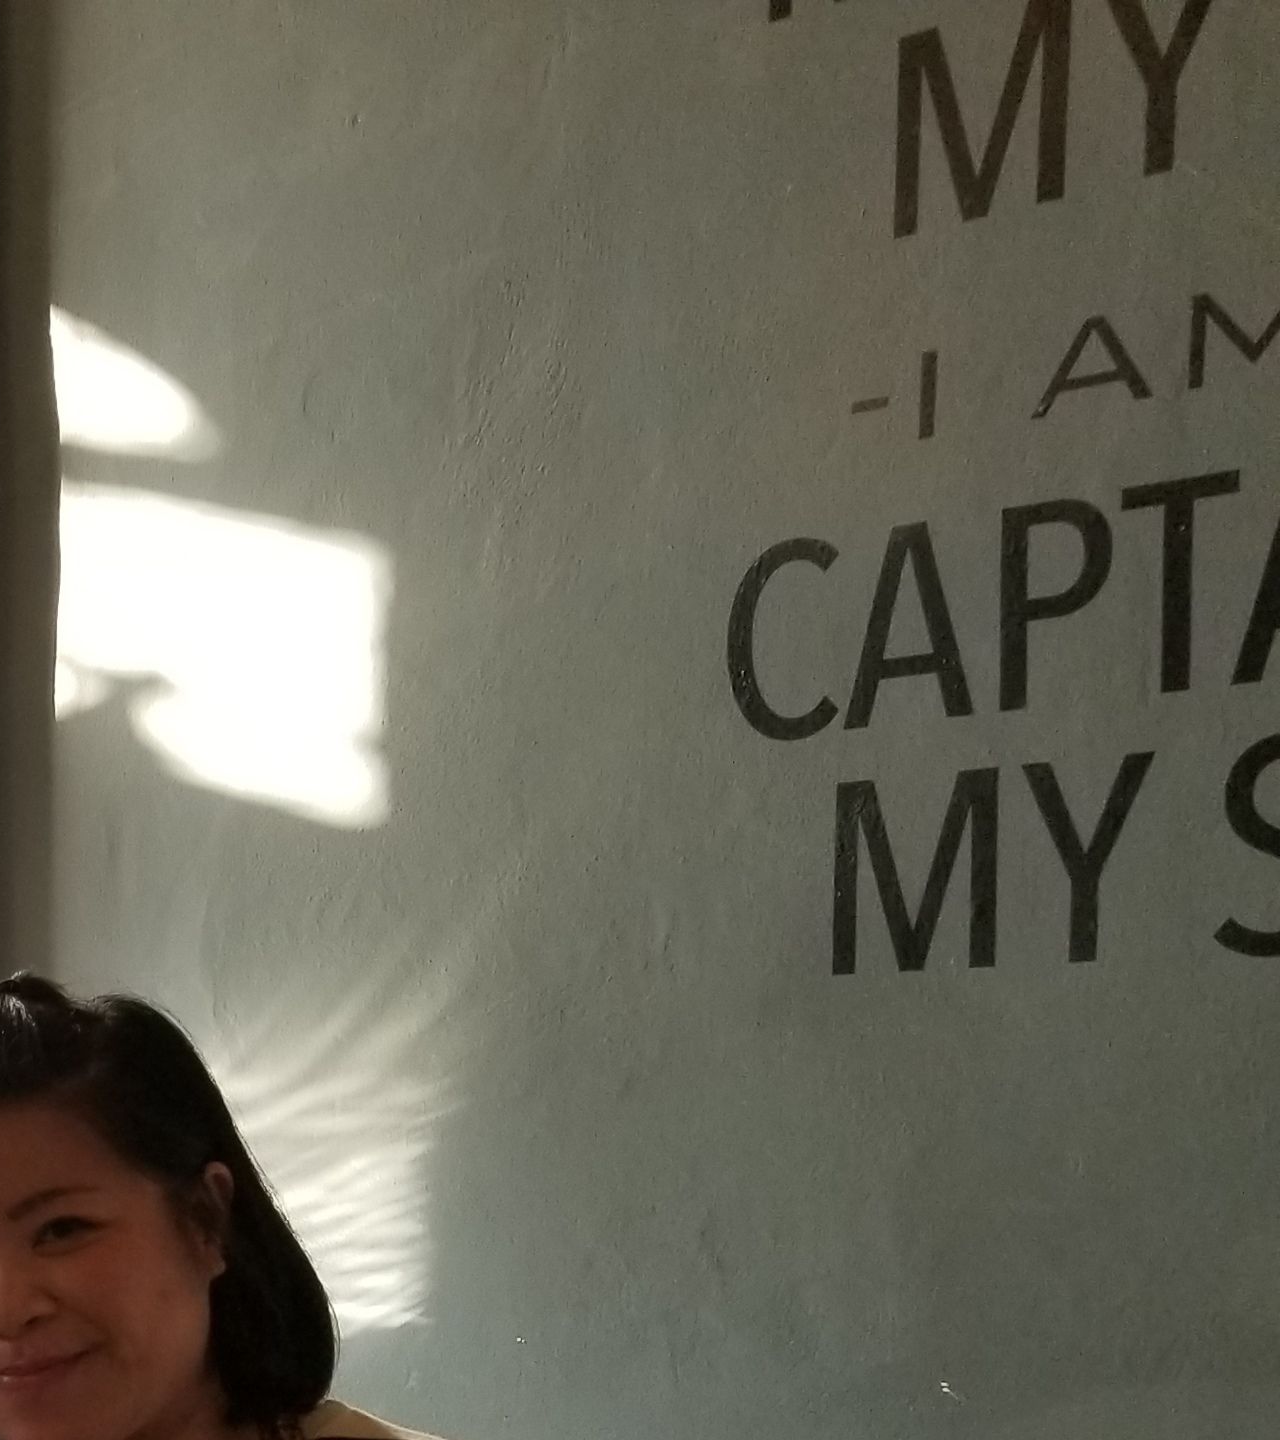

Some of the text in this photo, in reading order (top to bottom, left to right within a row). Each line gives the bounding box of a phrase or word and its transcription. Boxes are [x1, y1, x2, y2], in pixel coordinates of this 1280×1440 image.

[894, 0, 1212, 239] MY
[1030, 293, 1280, 419] AM
[831, 751, 1156, 976] MY
